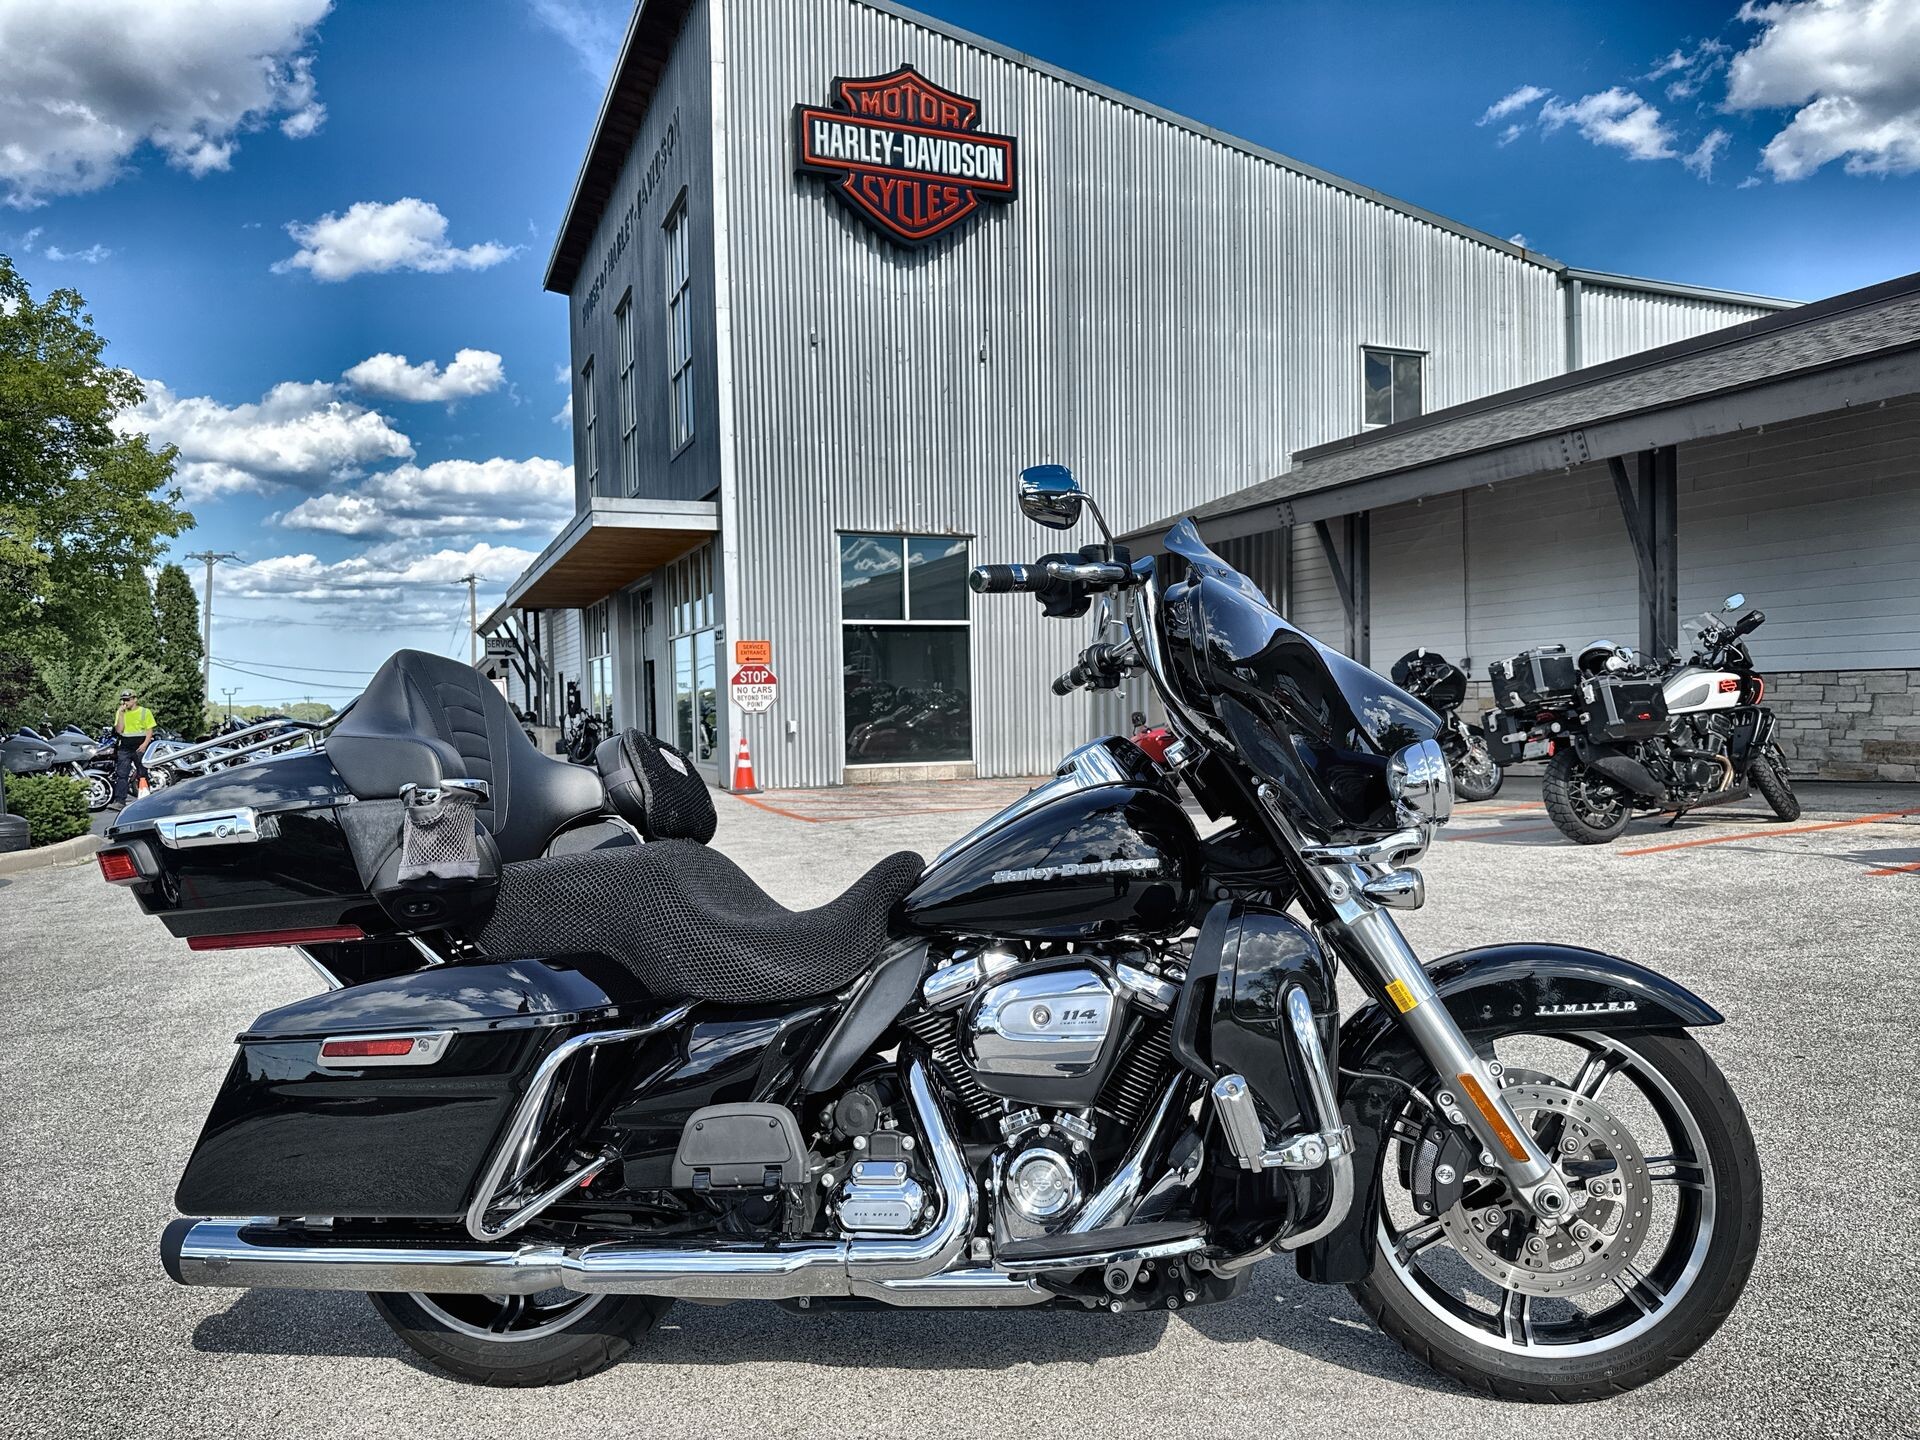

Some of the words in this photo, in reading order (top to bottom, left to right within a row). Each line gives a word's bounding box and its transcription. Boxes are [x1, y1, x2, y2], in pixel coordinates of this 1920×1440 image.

[860, 82, 960, 129] MOTOR
[813, 120, 1004, 182] HARLEY-DAVIDSON
[862, 174, 959, 227] CYCLES
[739, 670, 769, 684] STOP
[736, 686, 748, 694] NO
[751, 686, 773, 694] CARS
[991, 857, 1160, 884] Harley-Davidson
[1062, 1009, 1098, 1021] 114
[1538, 1001, 1637, 1015] LIMITED
